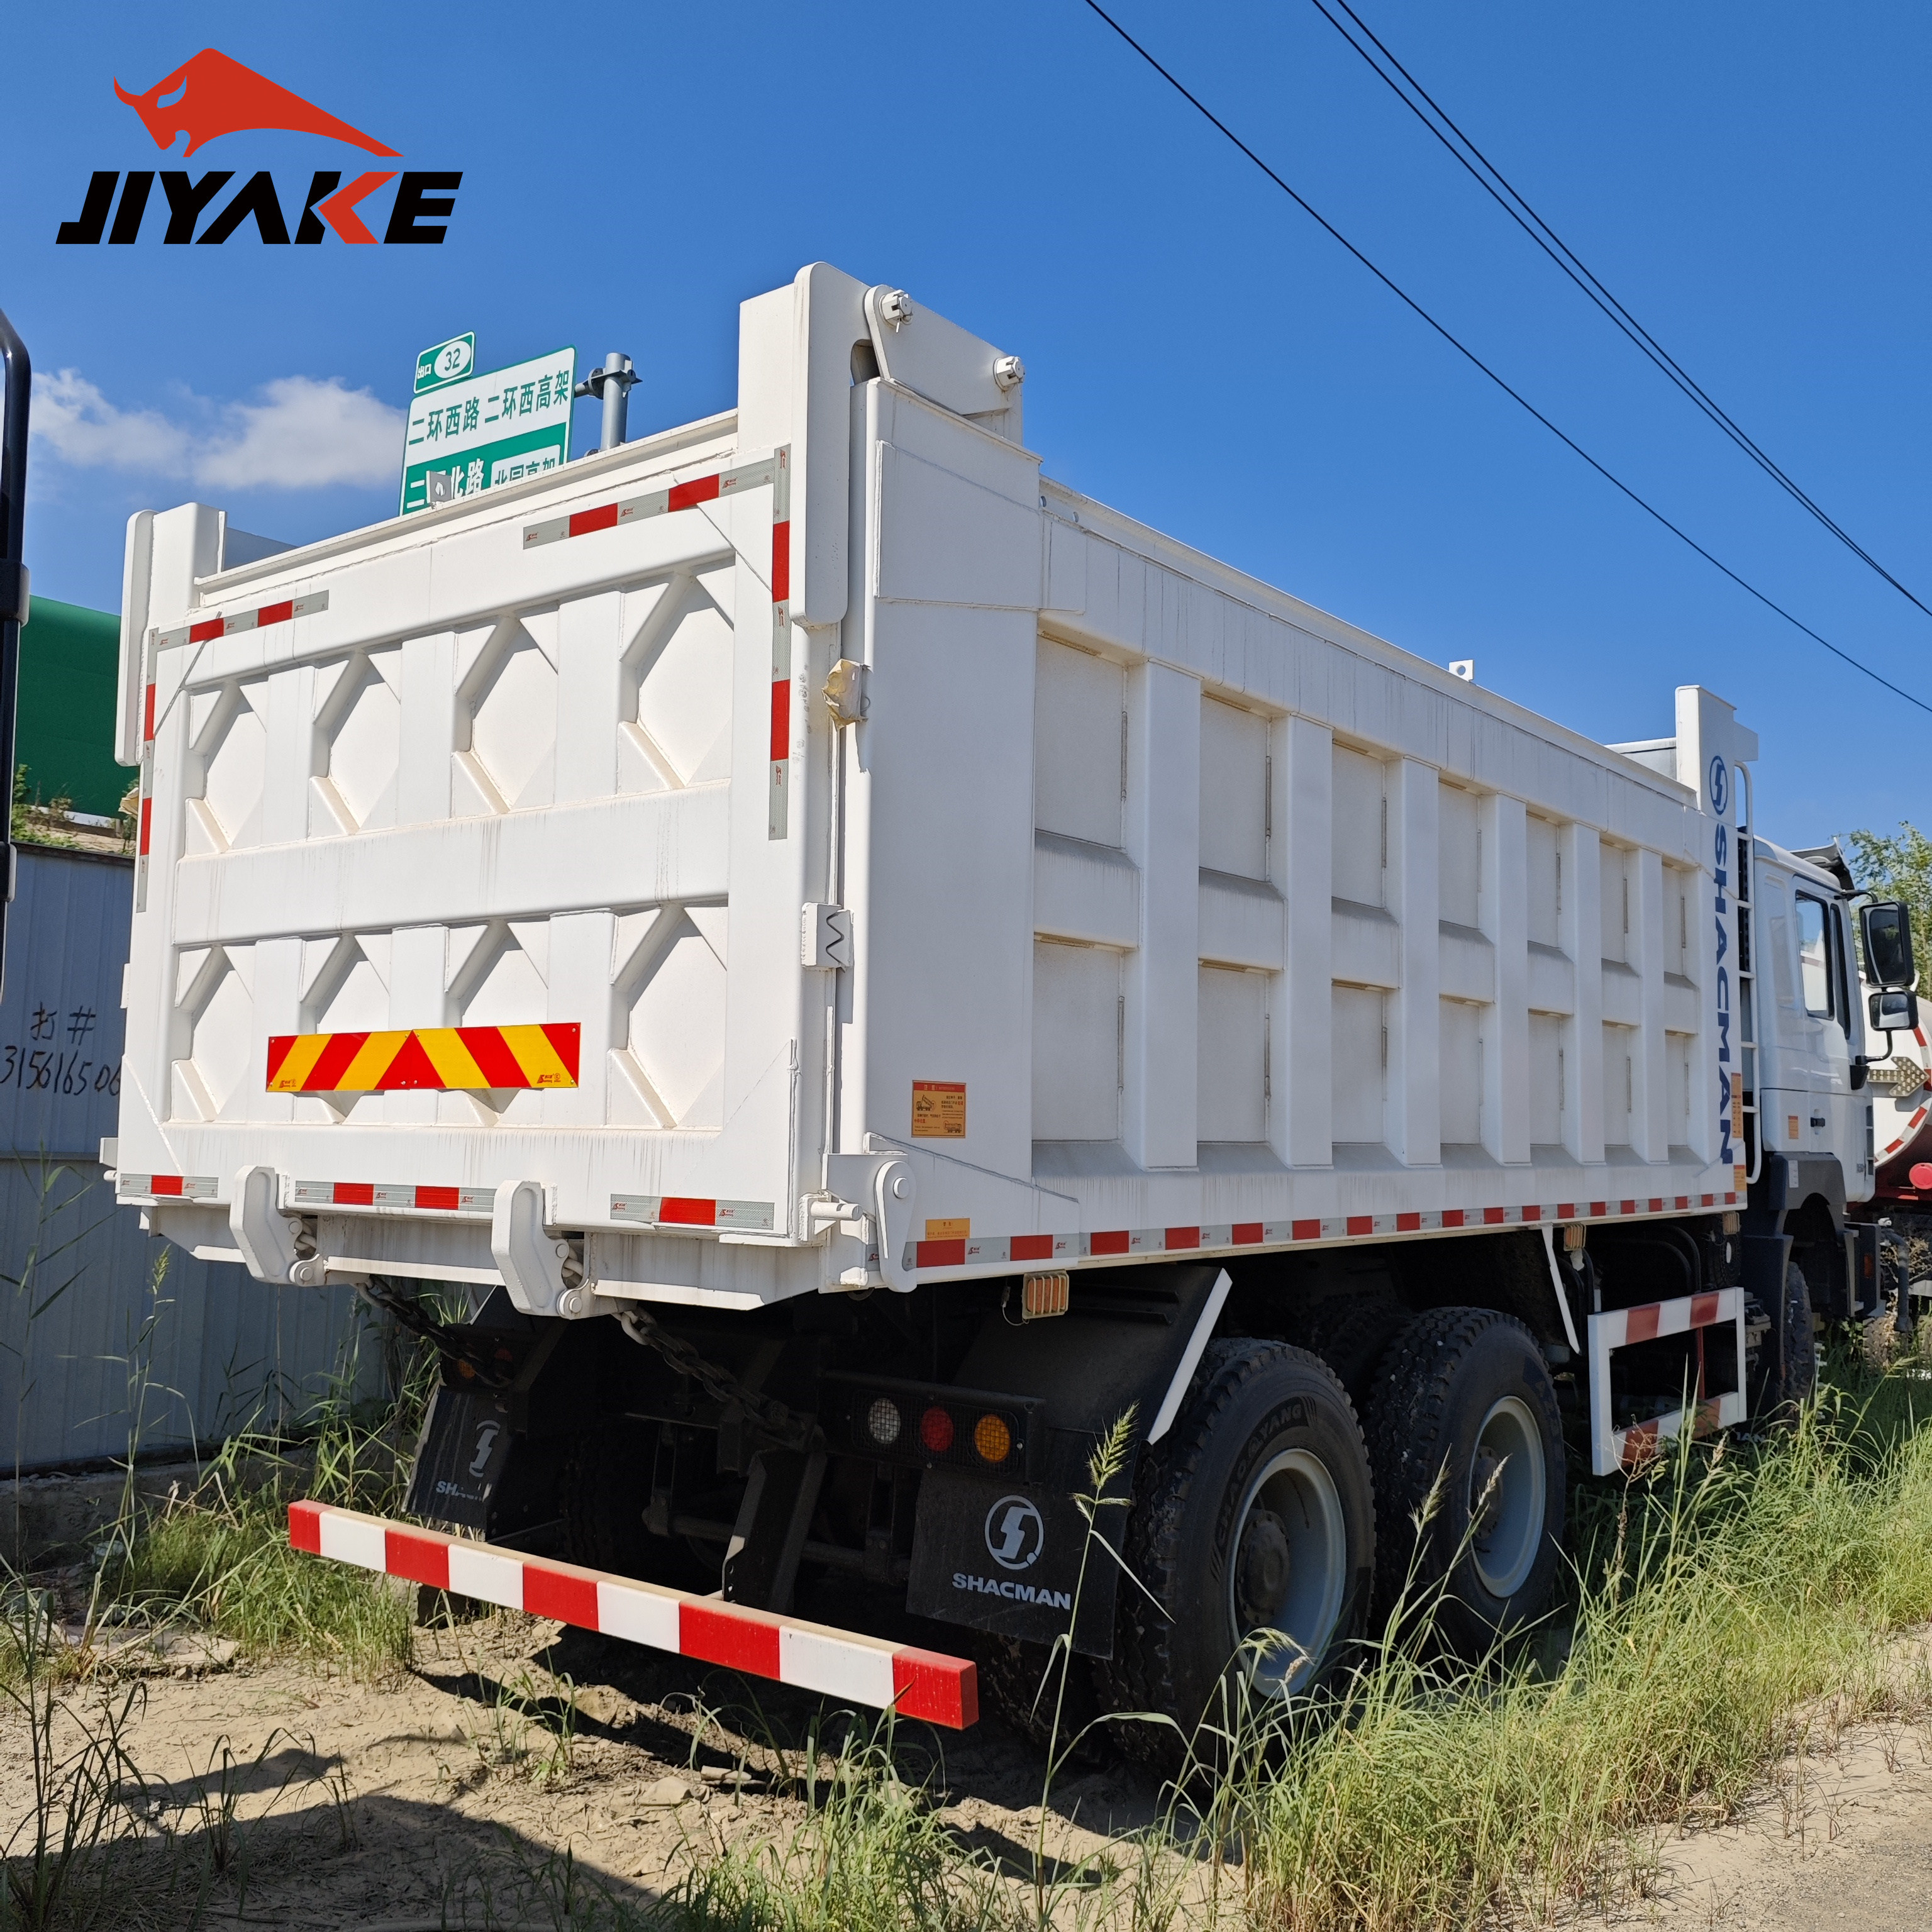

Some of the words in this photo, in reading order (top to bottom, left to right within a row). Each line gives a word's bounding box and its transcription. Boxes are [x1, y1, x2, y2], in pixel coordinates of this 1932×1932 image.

[417, 363, 431, 380] 出口
[444, 348, 461, 372] 32
[408, 397, 480, 445] 二环西路
[485, 370, 569, 424] 二环西高架
[406, 458, 484, 509] 二北路
[1714, 823, 1733, 1165] SHACMAN
[952, 1572, 1071, 1610] SHACMAN
